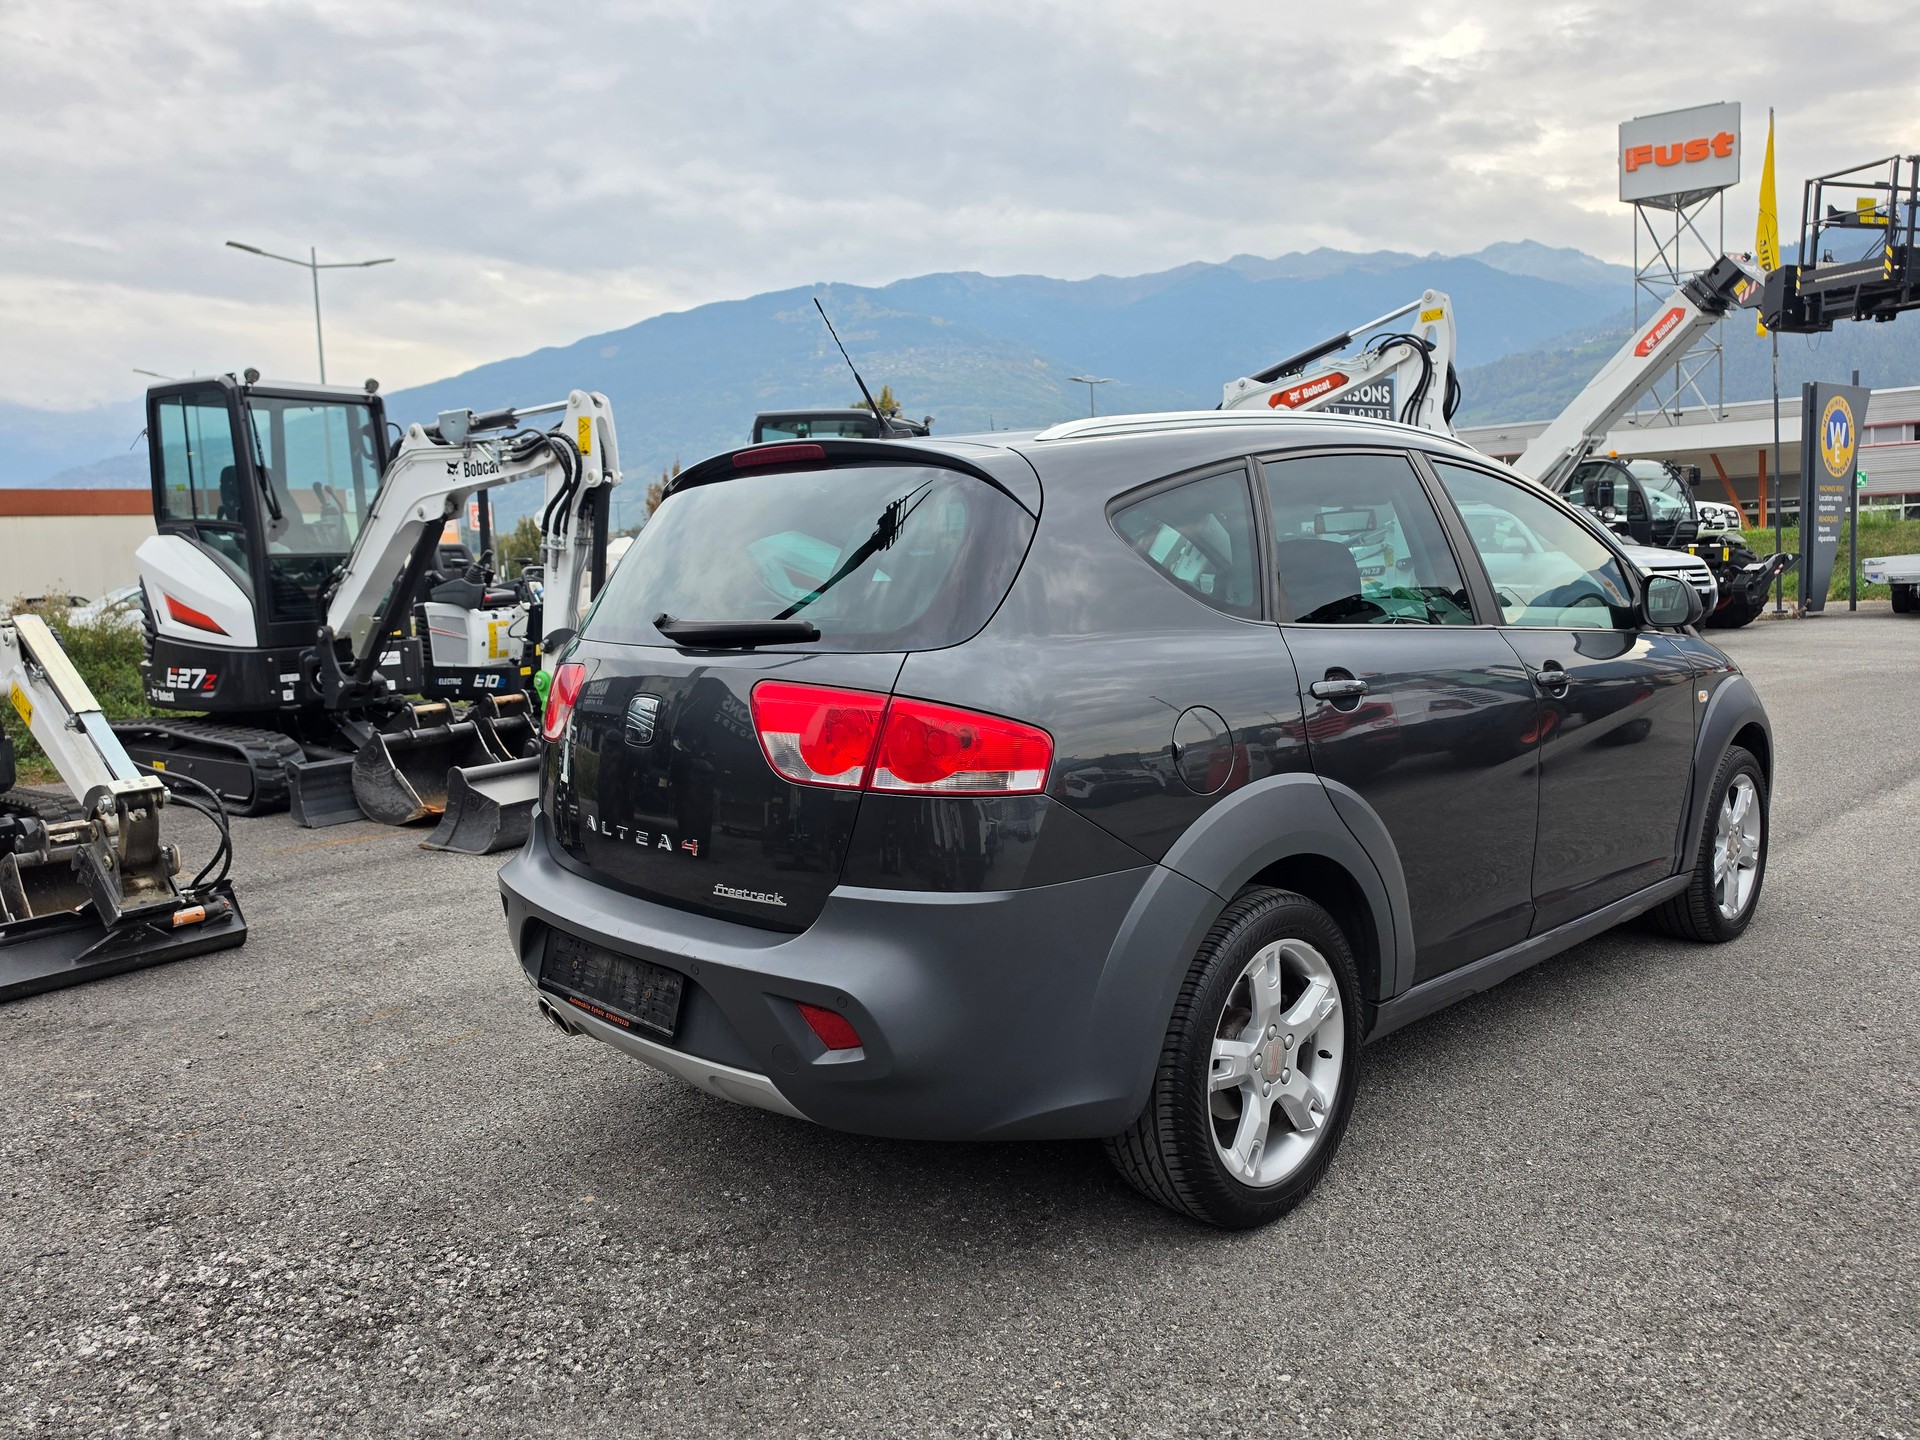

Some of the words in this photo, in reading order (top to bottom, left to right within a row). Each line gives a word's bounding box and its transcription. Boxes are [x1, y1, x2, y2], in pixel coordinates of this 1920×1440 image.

[1625, 131, 1735, 173] Fust
[1655, 313, 1678, 339] Bobcat
[1302, 379, 1331, 399] Bobcat
[1349, 409, 1390, 420] MONDE
[464, 459, 500, 478] Bobcat
[438, 677, 463, 686] ELECTRIC
[713, 884, 787, 907] freetrack
